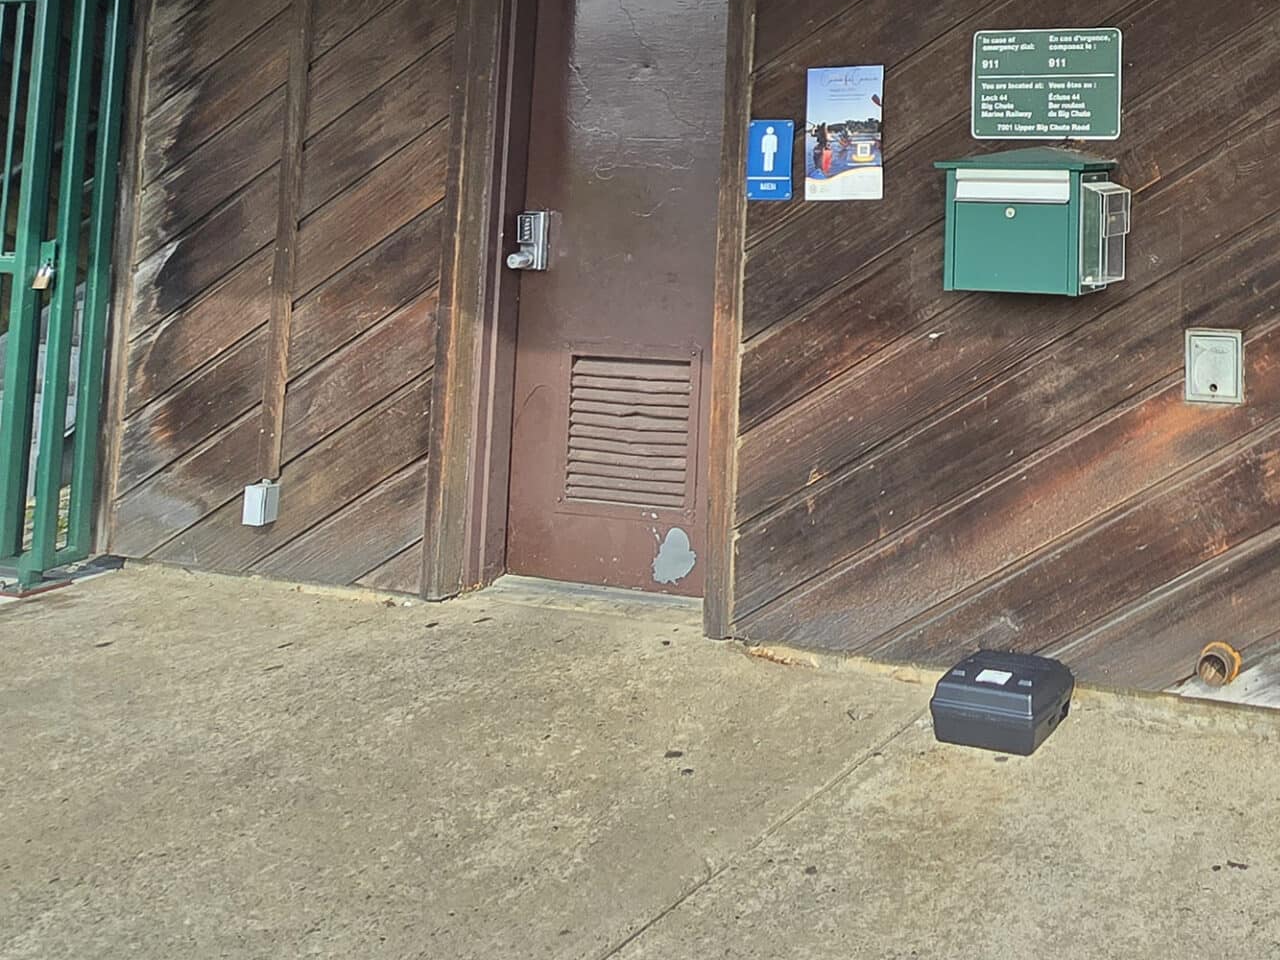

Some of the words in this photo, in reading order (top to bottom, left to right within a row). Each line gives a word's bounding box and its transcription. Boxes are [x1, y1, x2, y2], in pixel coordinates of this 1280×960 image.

[982, 44, 1019, 52] emergency
[982, 59, 999, 69] 911
[1048, 57, 1066, 68] 911
[981, 102, 993, 110] Big
[994, 102, 1014, 110] Chute
[1005, 110, 1032, 119] Railway
[1058, 110, 1069, 118] Big
[1014, 123, 1035, 132] Upper
[1036, 123, 1048, 132] Big
[1049, 123, 1070, 131] Chute
[1071, 123, 1090, 131] Road
[759, 182, 777, 191] MEN
